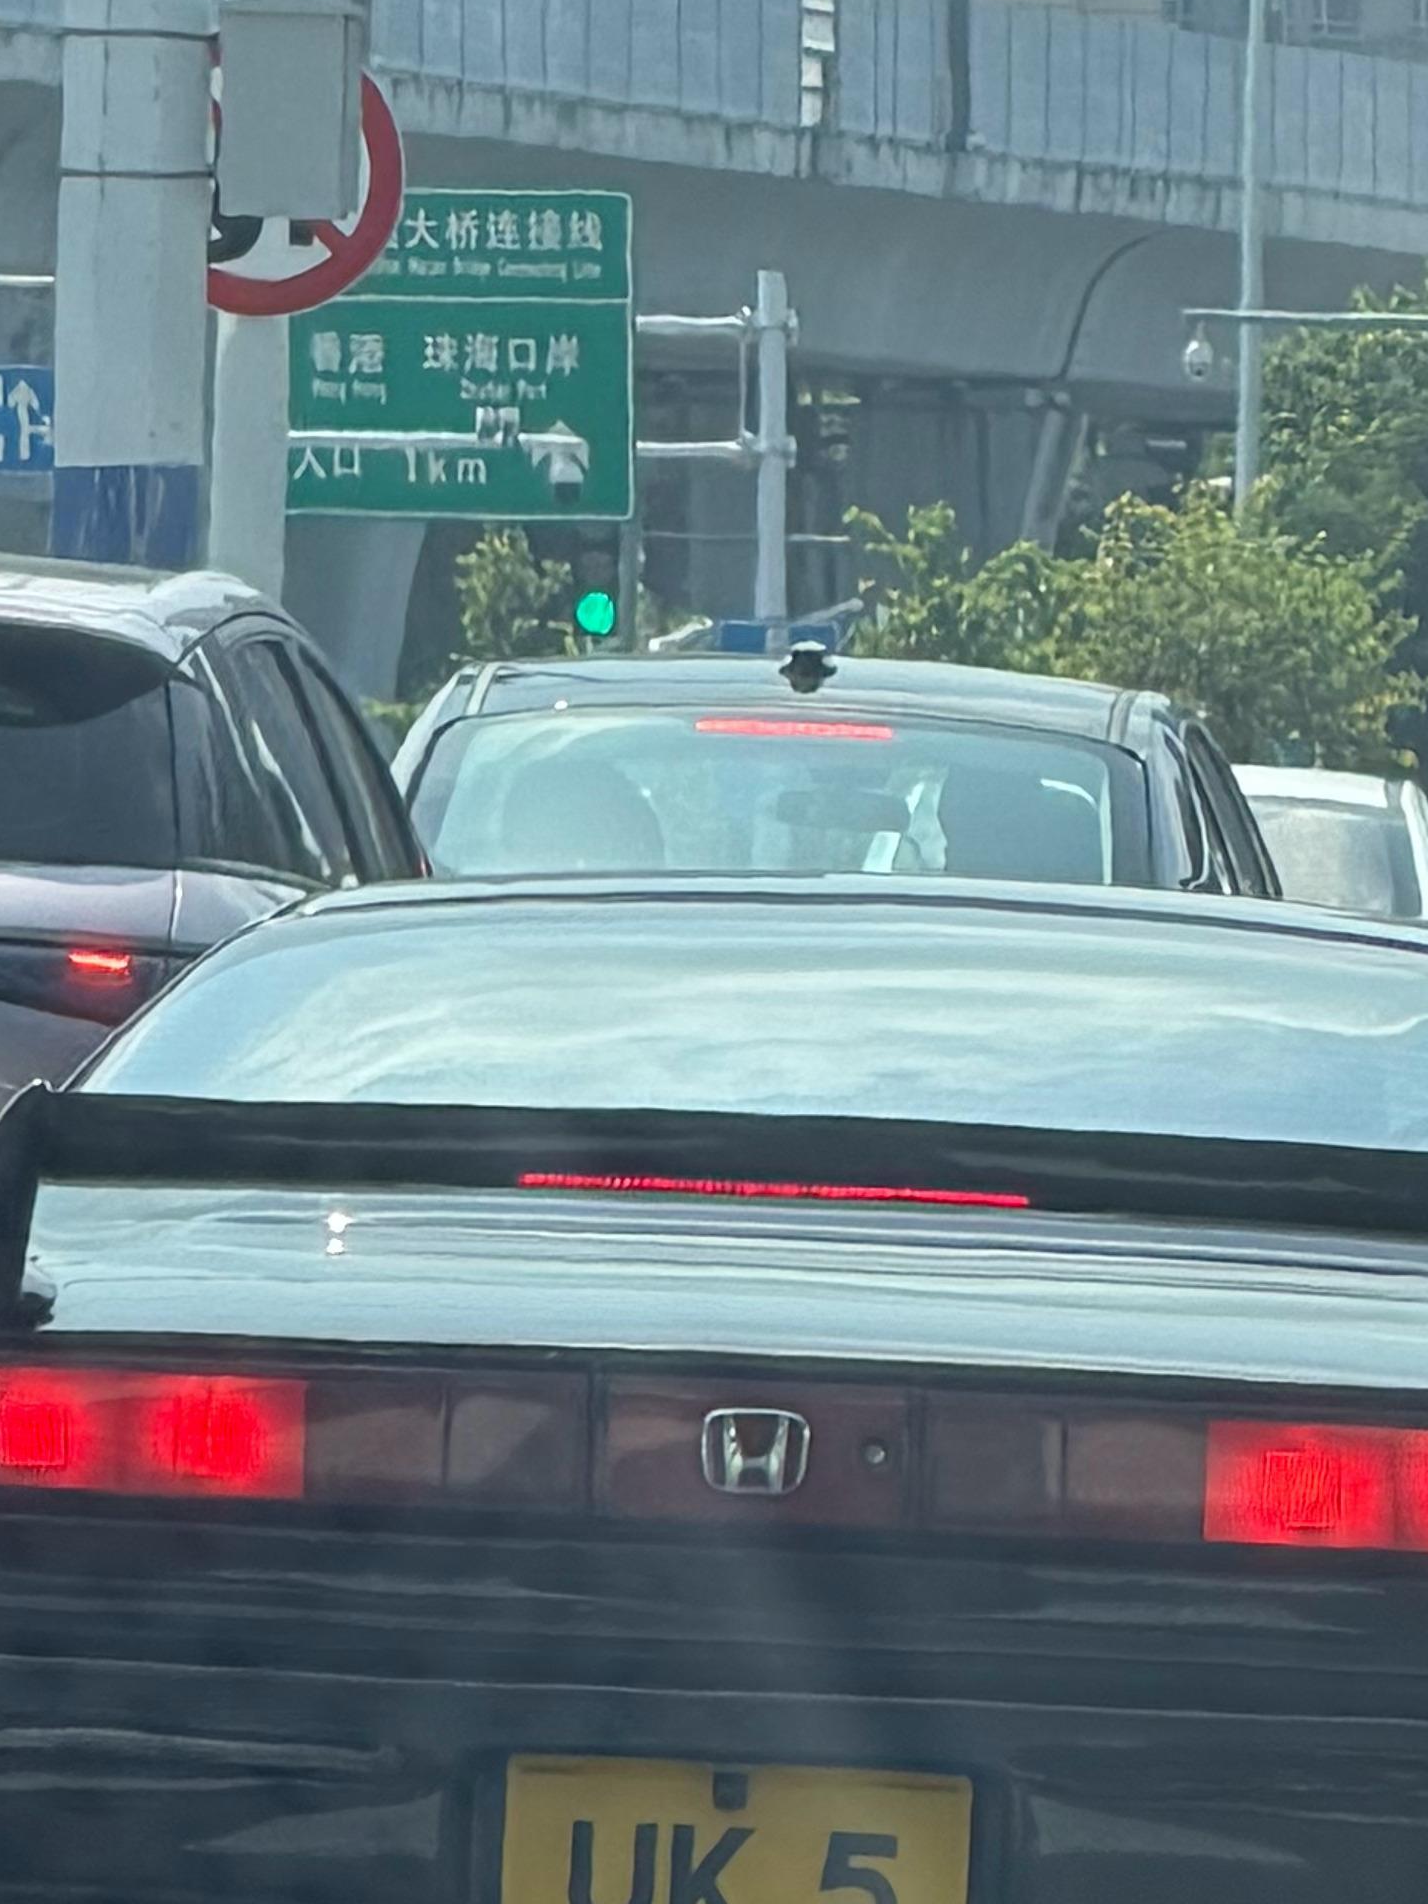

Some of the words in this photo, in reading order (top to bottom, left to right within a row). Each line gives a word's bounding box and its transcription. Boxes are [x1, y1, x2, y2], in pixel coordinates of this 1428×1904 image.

[386, 207, 603, 252] 大桥连接线
[422, 332, 580, 377] 珠海口岸
